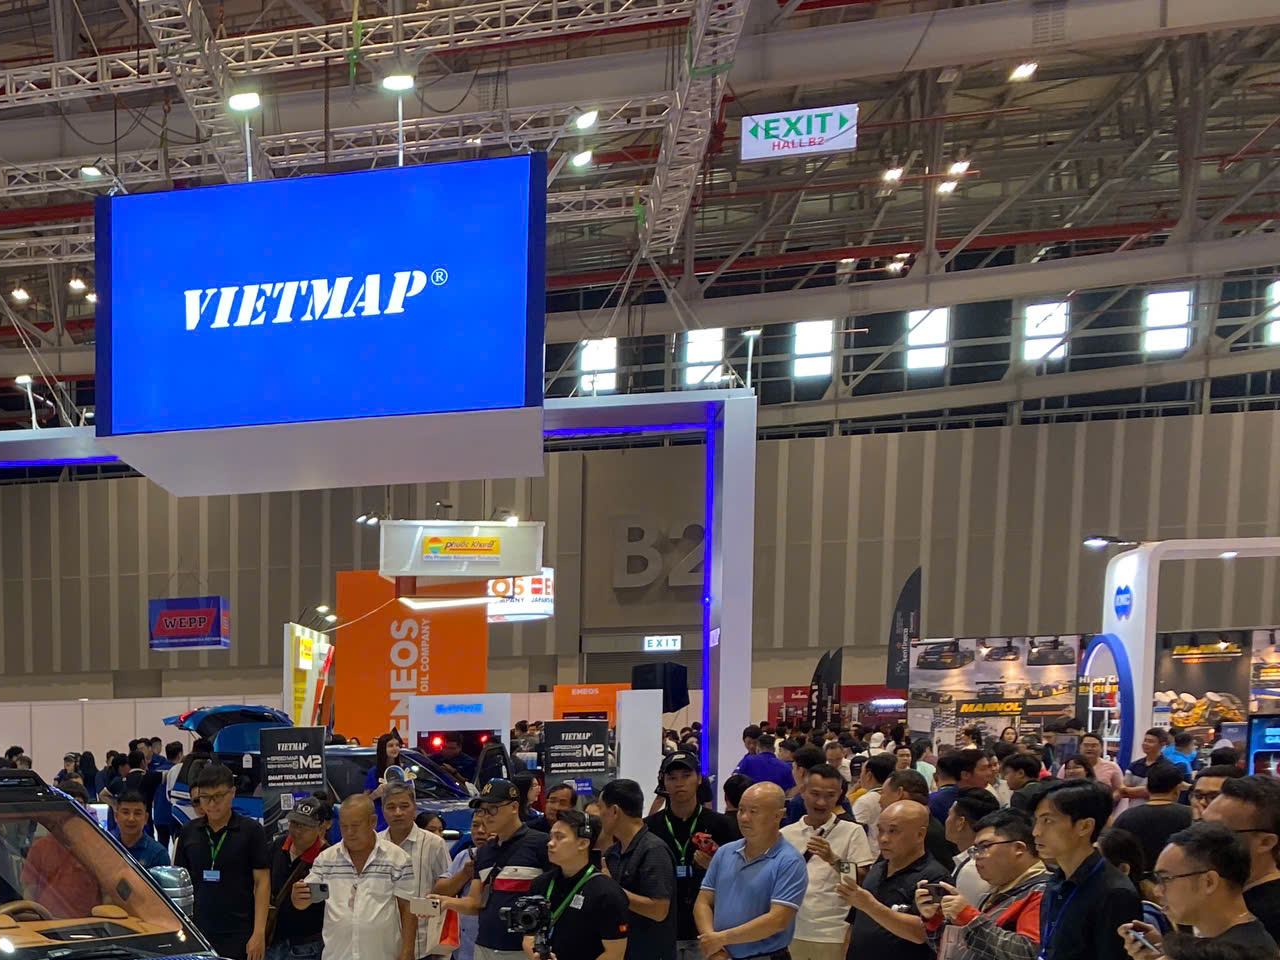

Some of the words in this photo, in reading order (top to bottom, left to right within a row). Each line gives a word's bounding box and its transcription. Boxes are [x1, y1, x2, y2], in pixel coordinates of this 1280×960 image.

[764, 112, 833, 140] EXIT
[613, 518, 707, 588] B2
[164, 616, 207, 628] WEPP
[420, 618, 431, 670] COMPANY
[648, 639, 678, 648] EXIT
[420, 676, 429, 692] OIL
[583, 744, 605, 757] M2
[300, 755, 322, 769] M2
